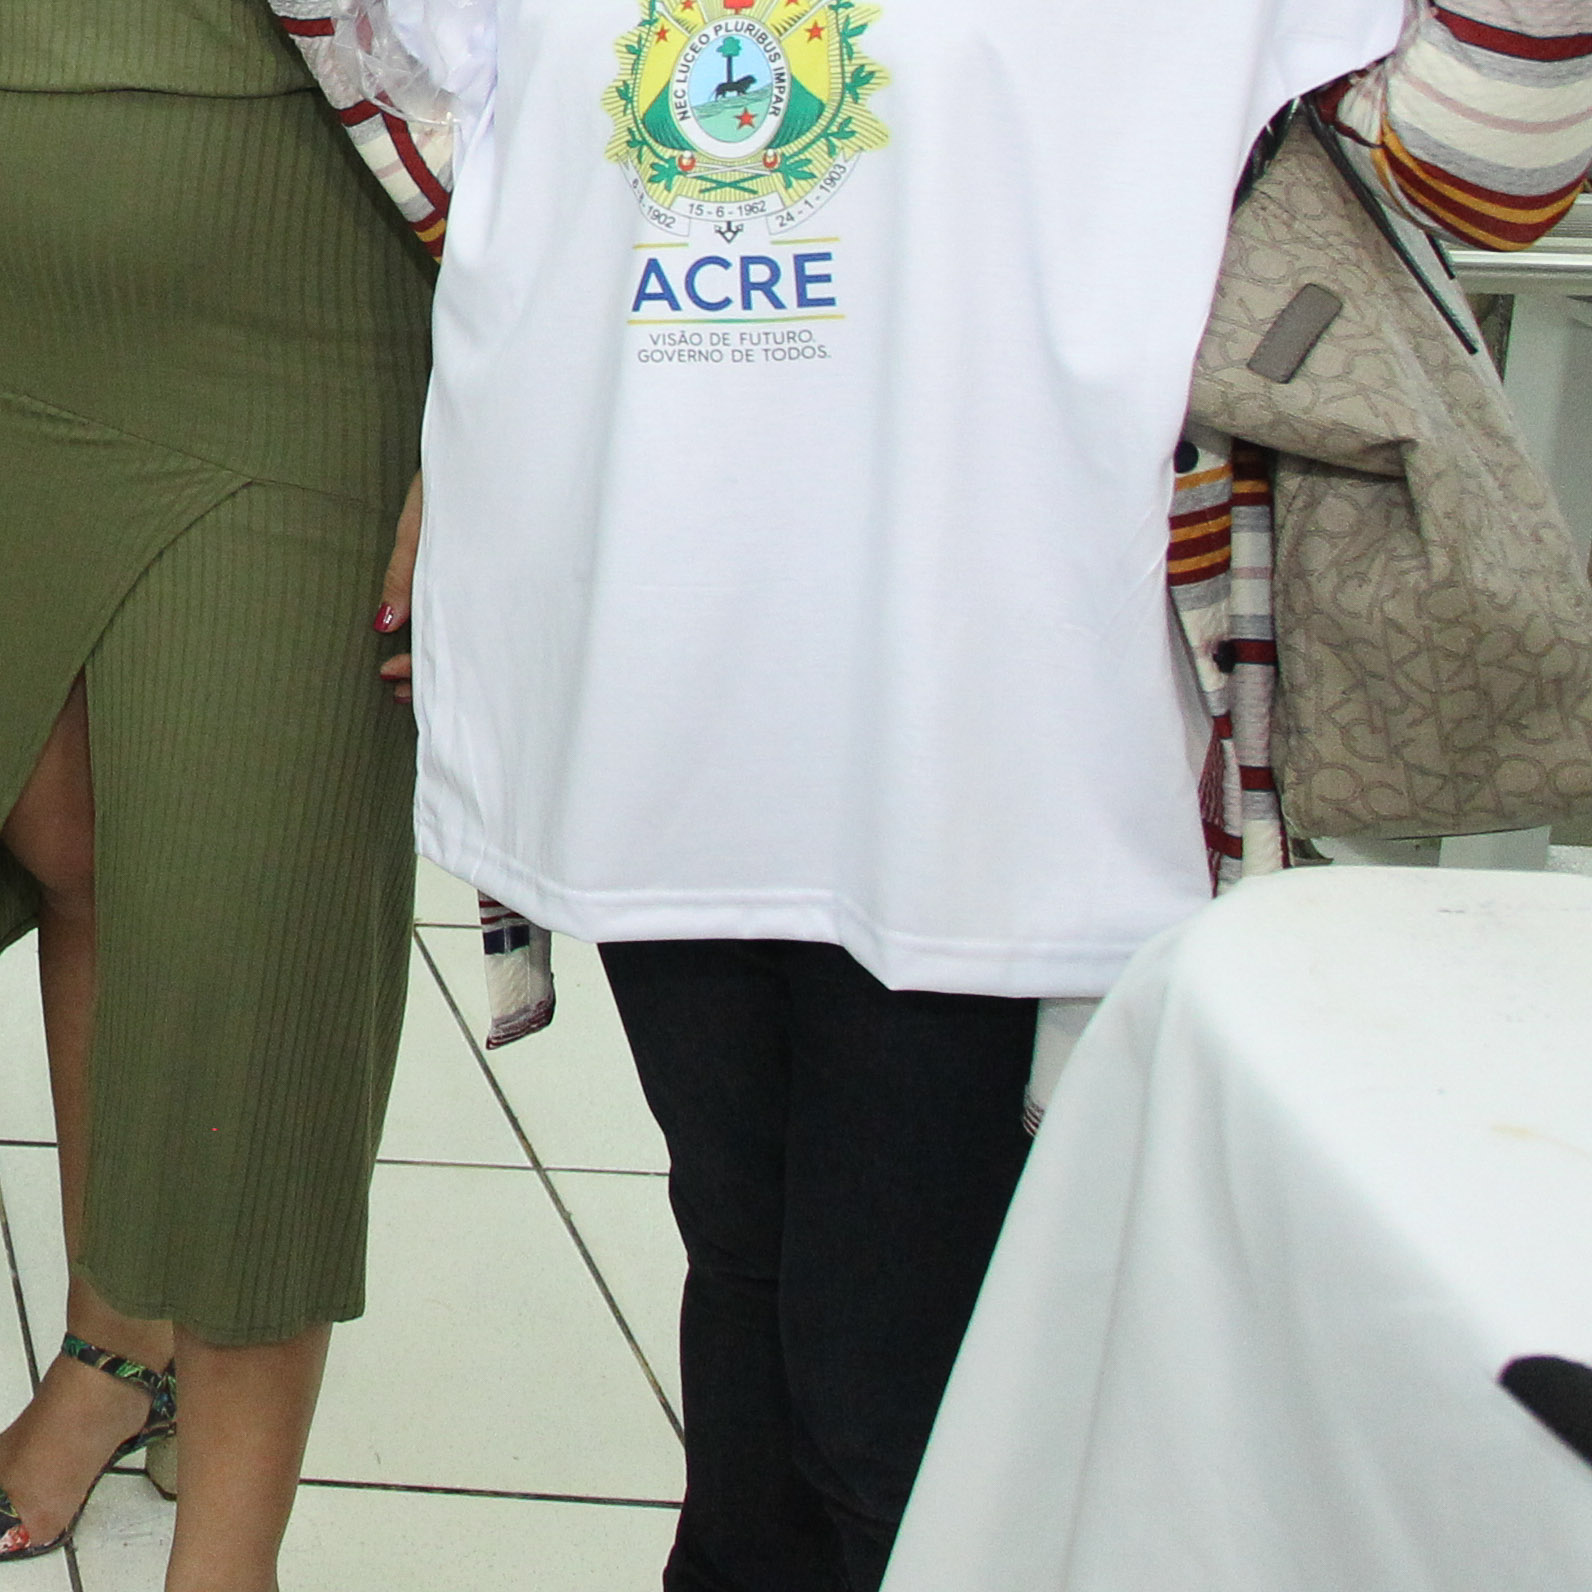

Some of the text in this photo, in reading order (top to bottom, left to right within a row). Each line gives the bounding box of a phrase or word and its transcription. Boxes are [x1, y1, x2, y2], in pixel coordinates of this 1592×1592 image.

[674, 21, 786, 121] NEC LUCEO PLURIBUS IMPAR
[631, 251, 837, 313] ACRE
[638, 348, 724, 363] GOVERNO
[731, 348, 755, 363] DE
[649, 330, 703, 347] VISÃO
[709, 332, 732, 347] DE
